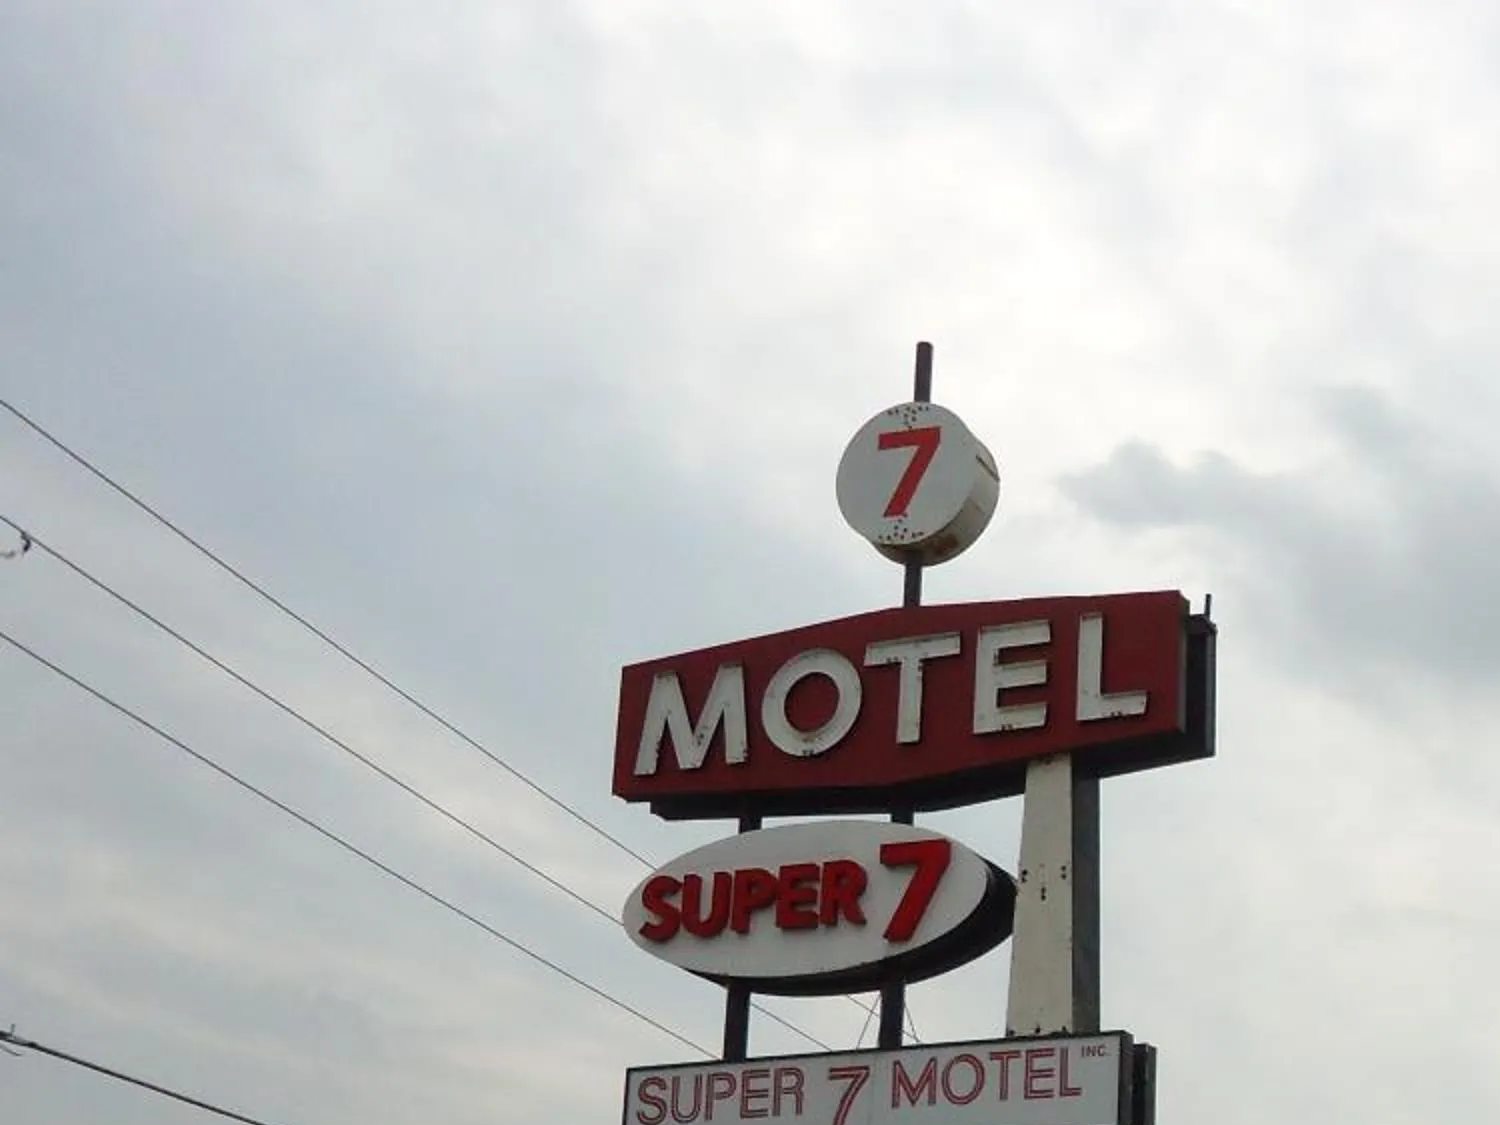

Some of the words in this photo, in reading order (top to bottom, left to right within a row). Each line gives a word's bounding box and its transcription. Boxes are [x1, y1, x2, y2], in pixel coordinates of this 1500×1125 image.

[877, 426, 941, 518] 7
[633, 613, 1148, 776] MOTEL
[638, 857, 868, 944] SUPER
[879, 838, 952, 943] 7
[891, 1047, 1082, 1110] MOTEL
